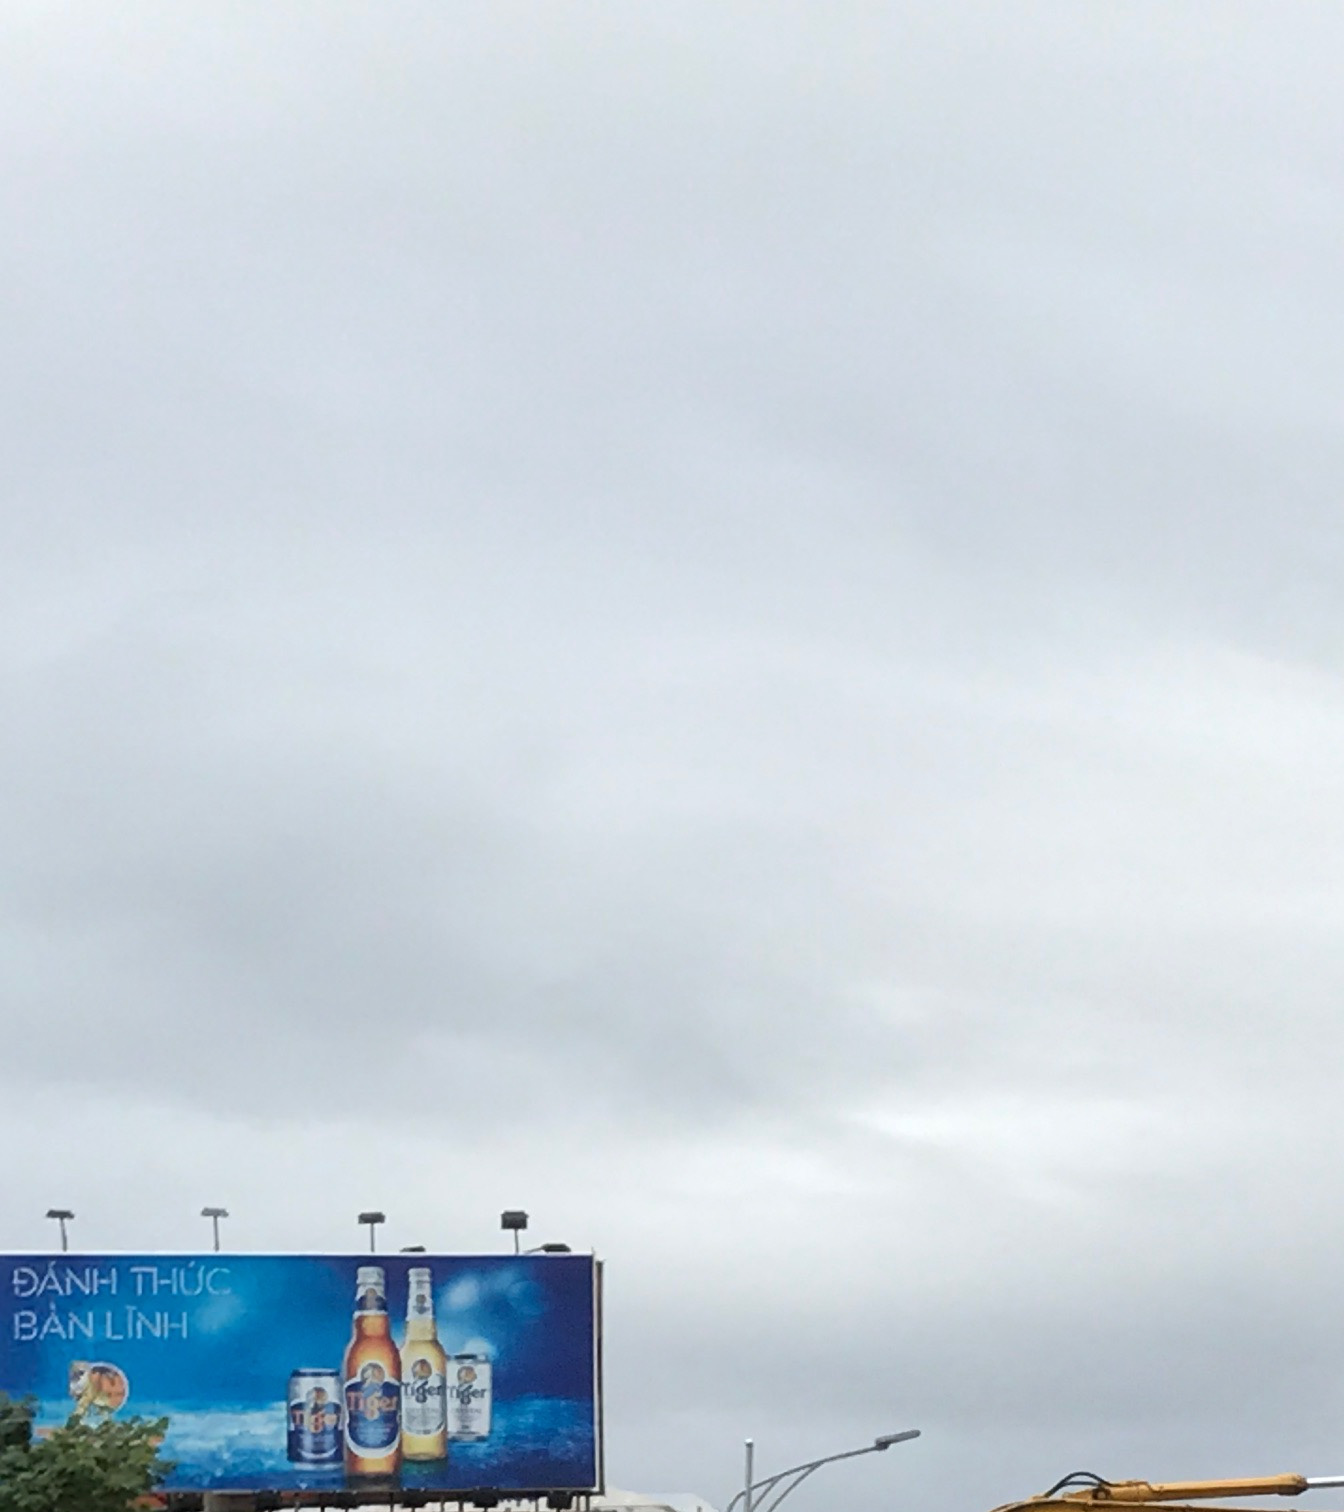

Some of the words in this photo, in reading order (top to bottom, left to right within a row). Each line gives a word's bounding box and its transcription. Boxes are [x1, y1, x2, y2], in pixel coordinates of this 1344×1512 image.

[12, 1261, 117, 1297] ĐÁNH
[130, 1261, 231, 1296] THÚC
[13, 1303, 94, 1341] BẢN
[106, 1305, 187, 1340] LĨNH
[401, 1381, 442, 1404] Tiger
[447, 1384, 487, 1405] Tiger
